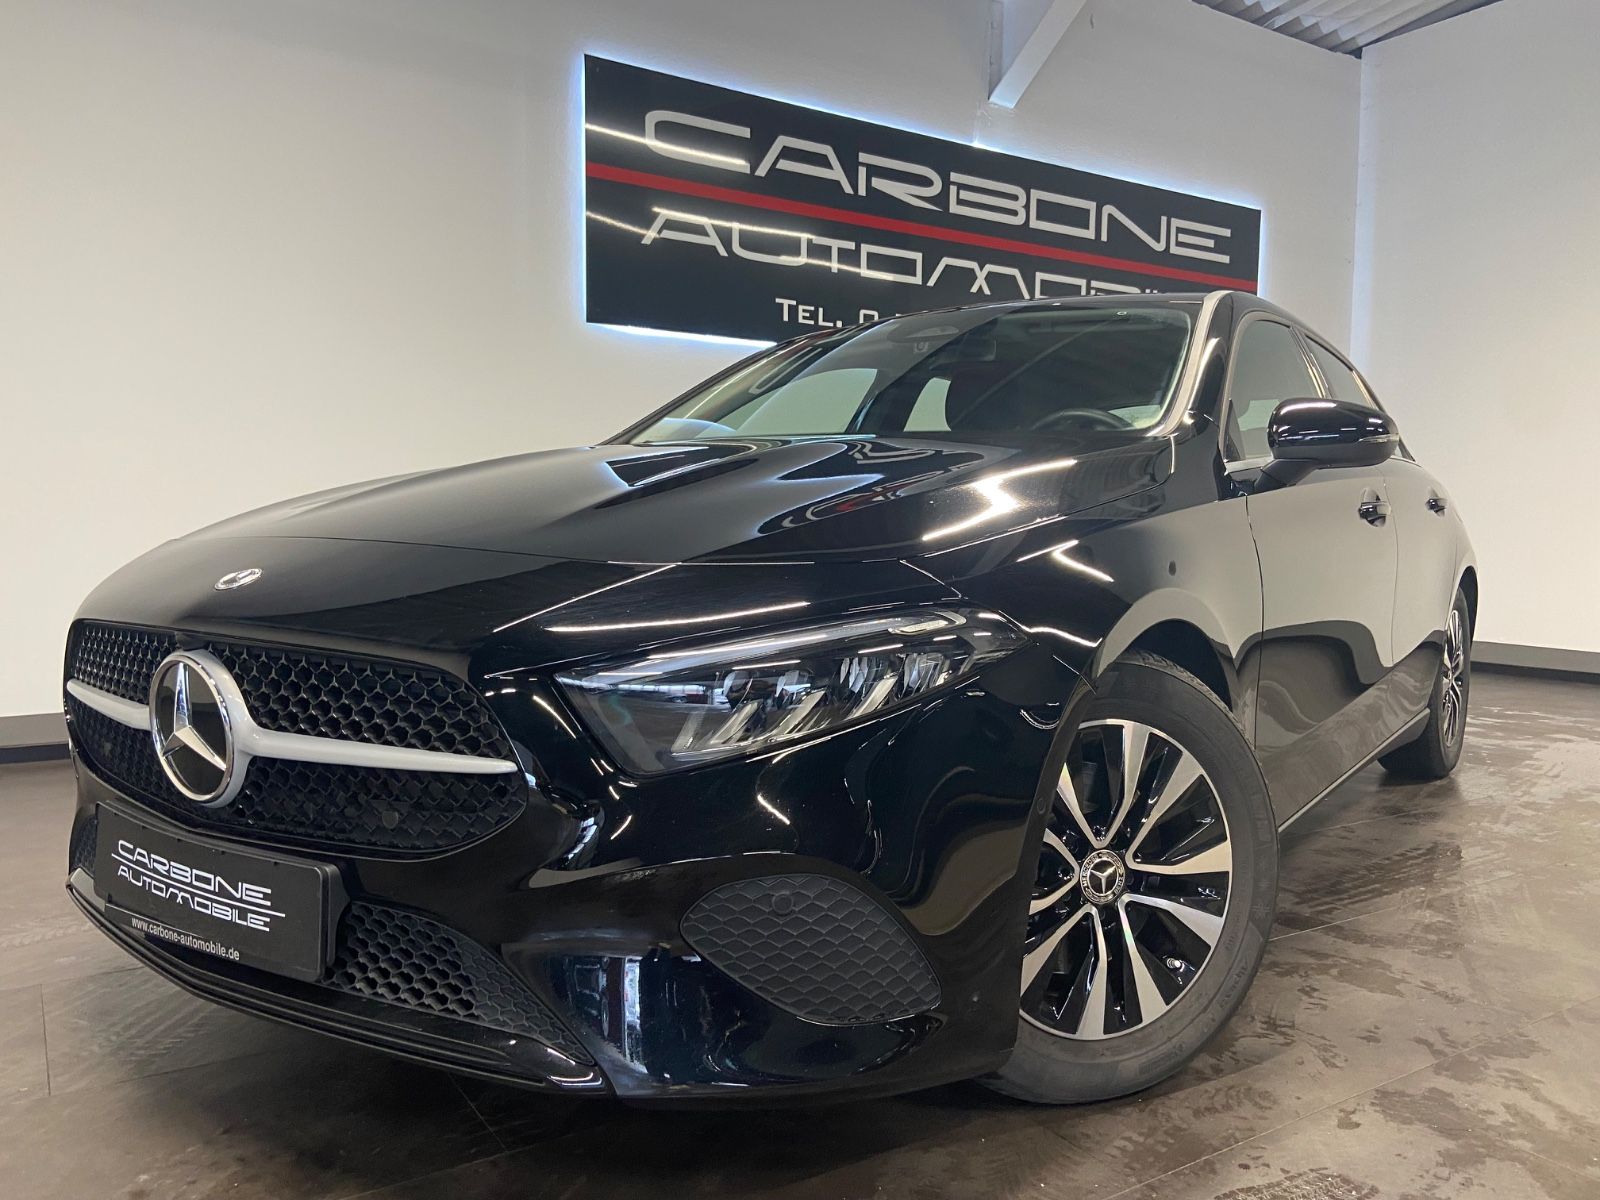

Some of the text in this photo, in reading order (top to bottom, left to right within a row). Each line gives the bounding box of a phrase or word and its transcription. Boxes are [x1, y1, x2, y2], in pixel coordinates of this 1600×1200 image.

[644, 109, 1231, 264] CARBONE
[117, 839, 272, 906] CARBONE
[117, 864, 271, 932] AUTOMOBILE
[131, 917, 240, 960] www.carbone-automobile.de
